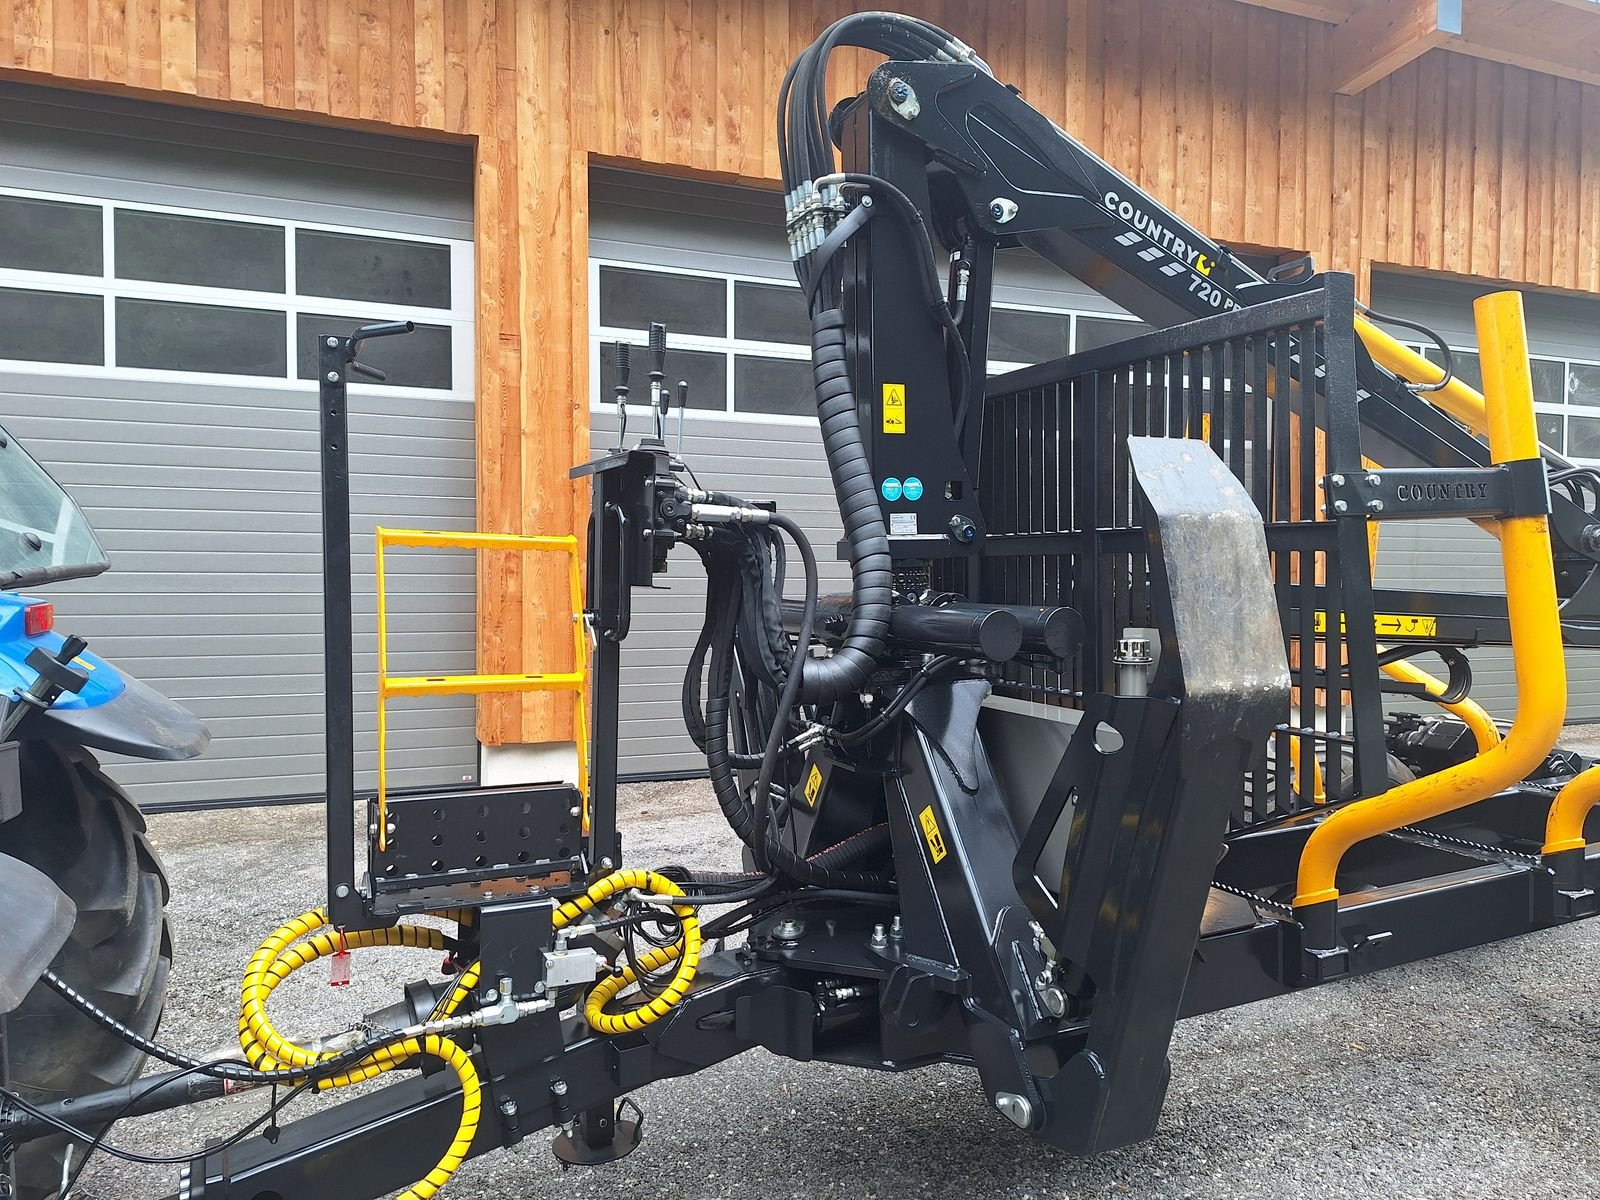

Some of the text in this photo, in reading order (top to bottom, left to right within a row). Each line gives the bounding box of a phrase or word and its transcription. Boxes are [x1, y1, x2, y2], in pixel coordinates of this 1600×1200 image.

[1104, 191, 1200, 265] COUNTRY
[1188, 274, 1222, 308] 720
[1397, 483, 1488, 502] COUNTRY
